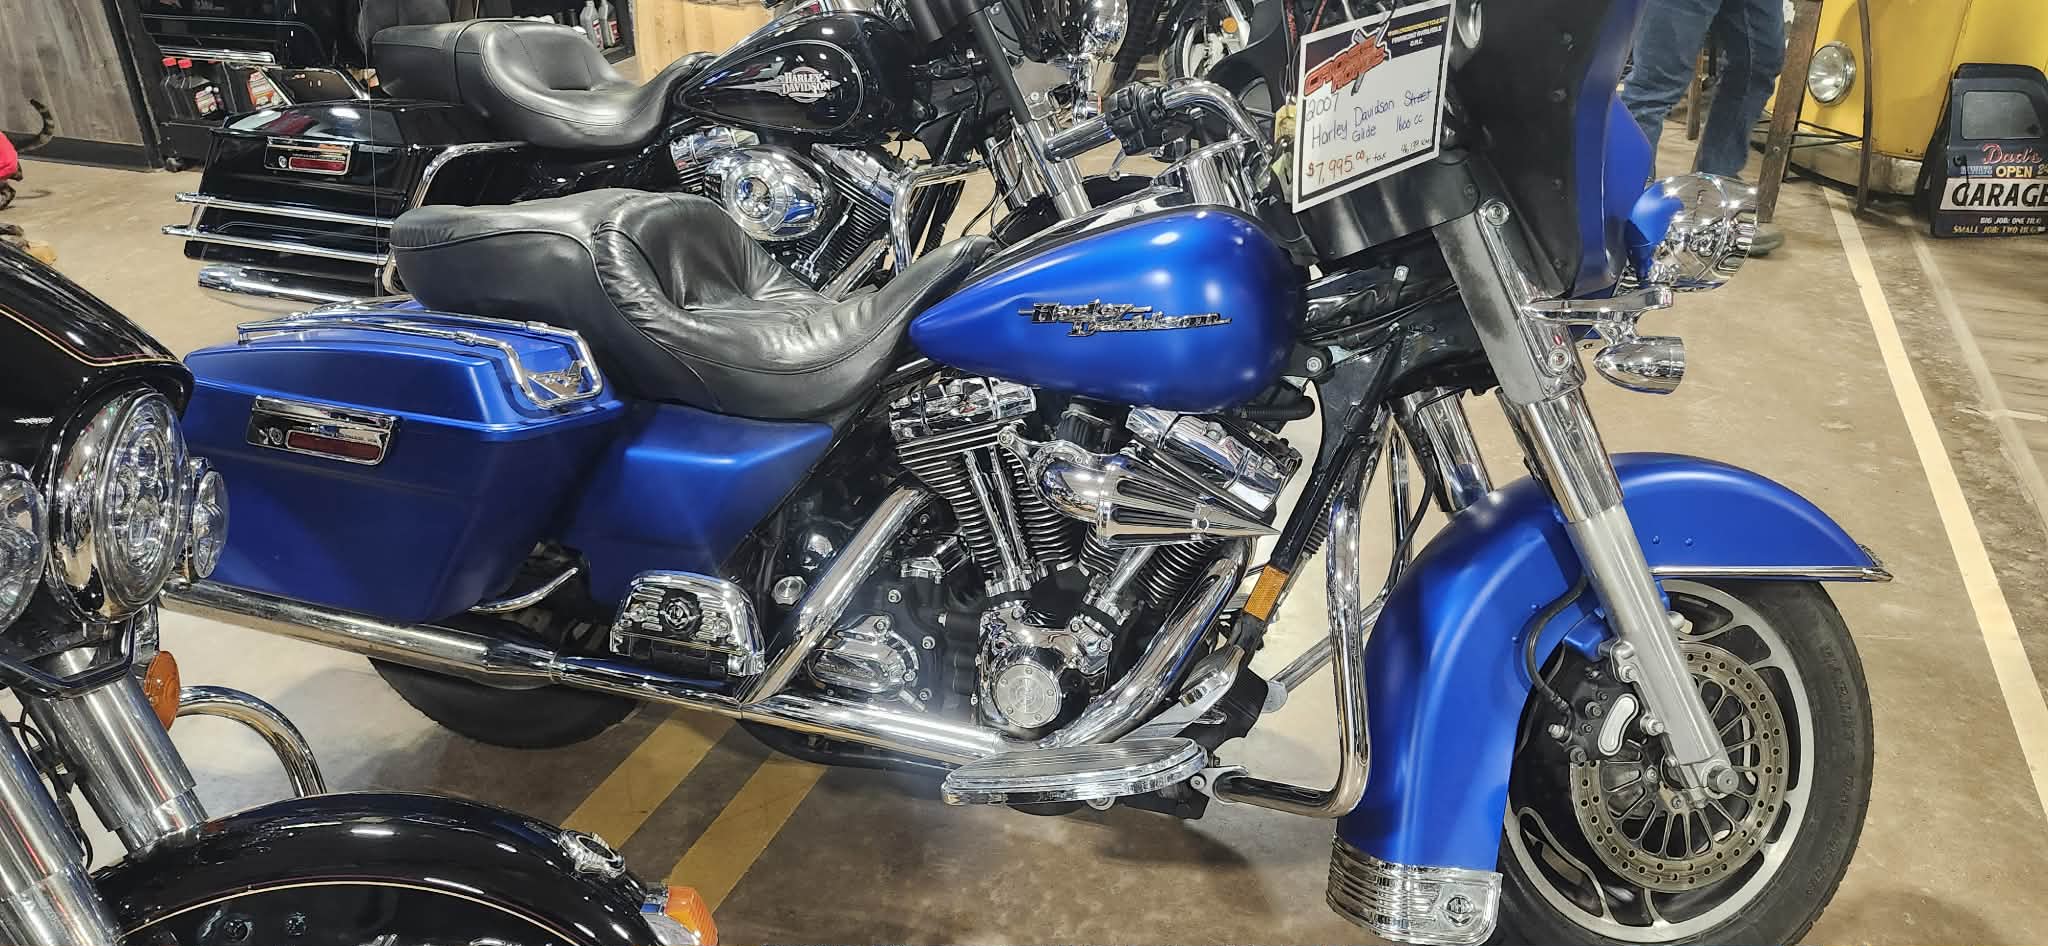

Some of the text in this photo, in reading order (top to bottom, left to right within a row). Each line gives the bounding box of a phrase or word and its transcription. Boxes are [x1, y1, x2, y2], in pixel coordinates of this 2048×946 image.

[782, 80, 832, 95] DAVIDSON
[1306, 92, 1340, 122] 2007
[1312, 119, 1348, 149] Harley
[1353, 100, 1395, 127] Davidson
[1983, 143, 2042, 165] Dad's
[1995, 165, 2033, 178] OPEN
[1951, 182, 2048, 207] GARAGE
